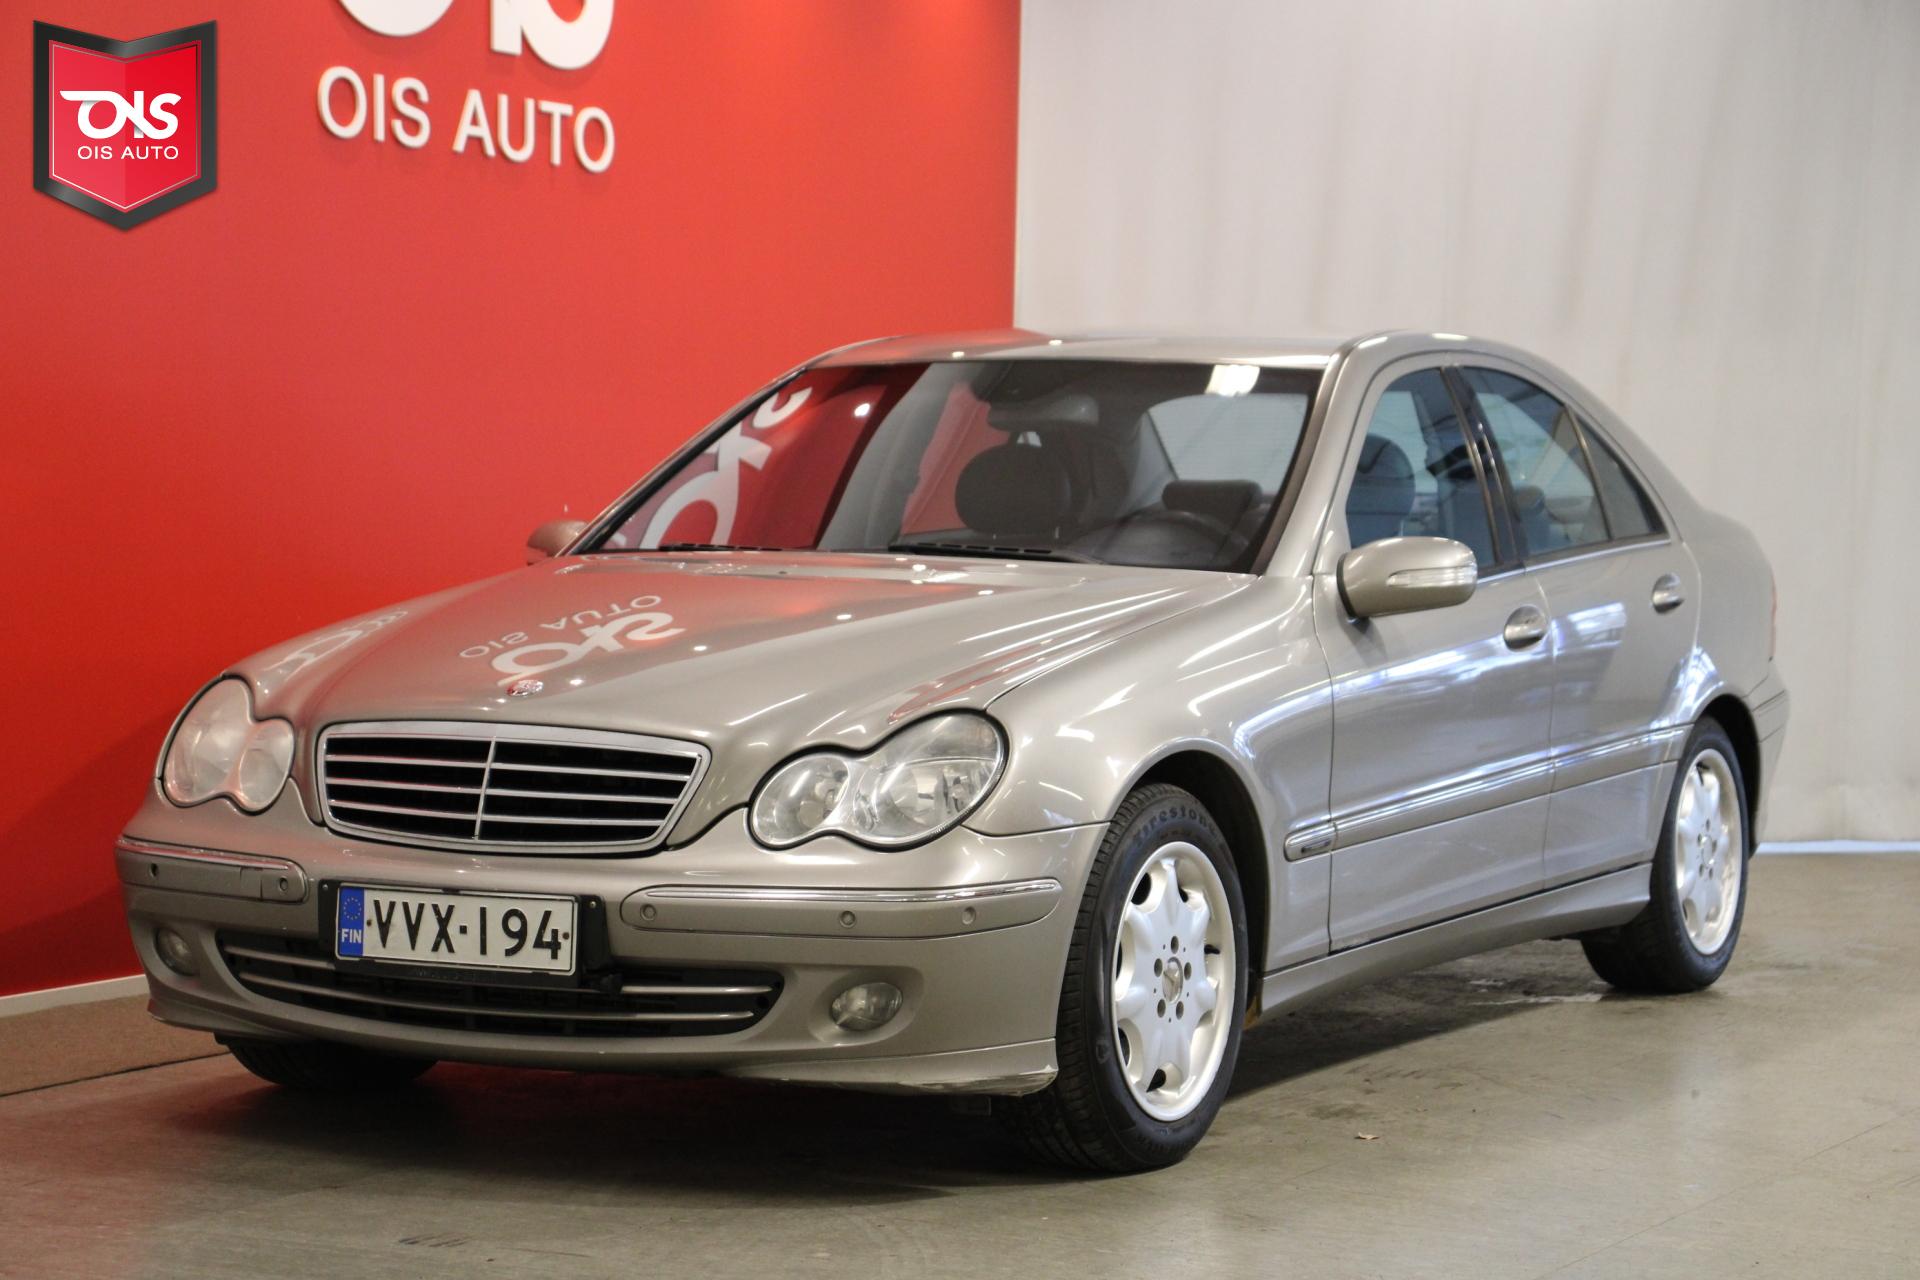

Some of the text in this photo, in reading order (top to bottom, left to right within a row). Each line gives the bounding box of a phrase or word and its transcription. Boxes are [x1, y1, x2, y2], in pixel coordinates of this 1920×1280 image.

[317, 65, 616, 173] OIS AUTO
[341, 928, 362, 944] FIN
